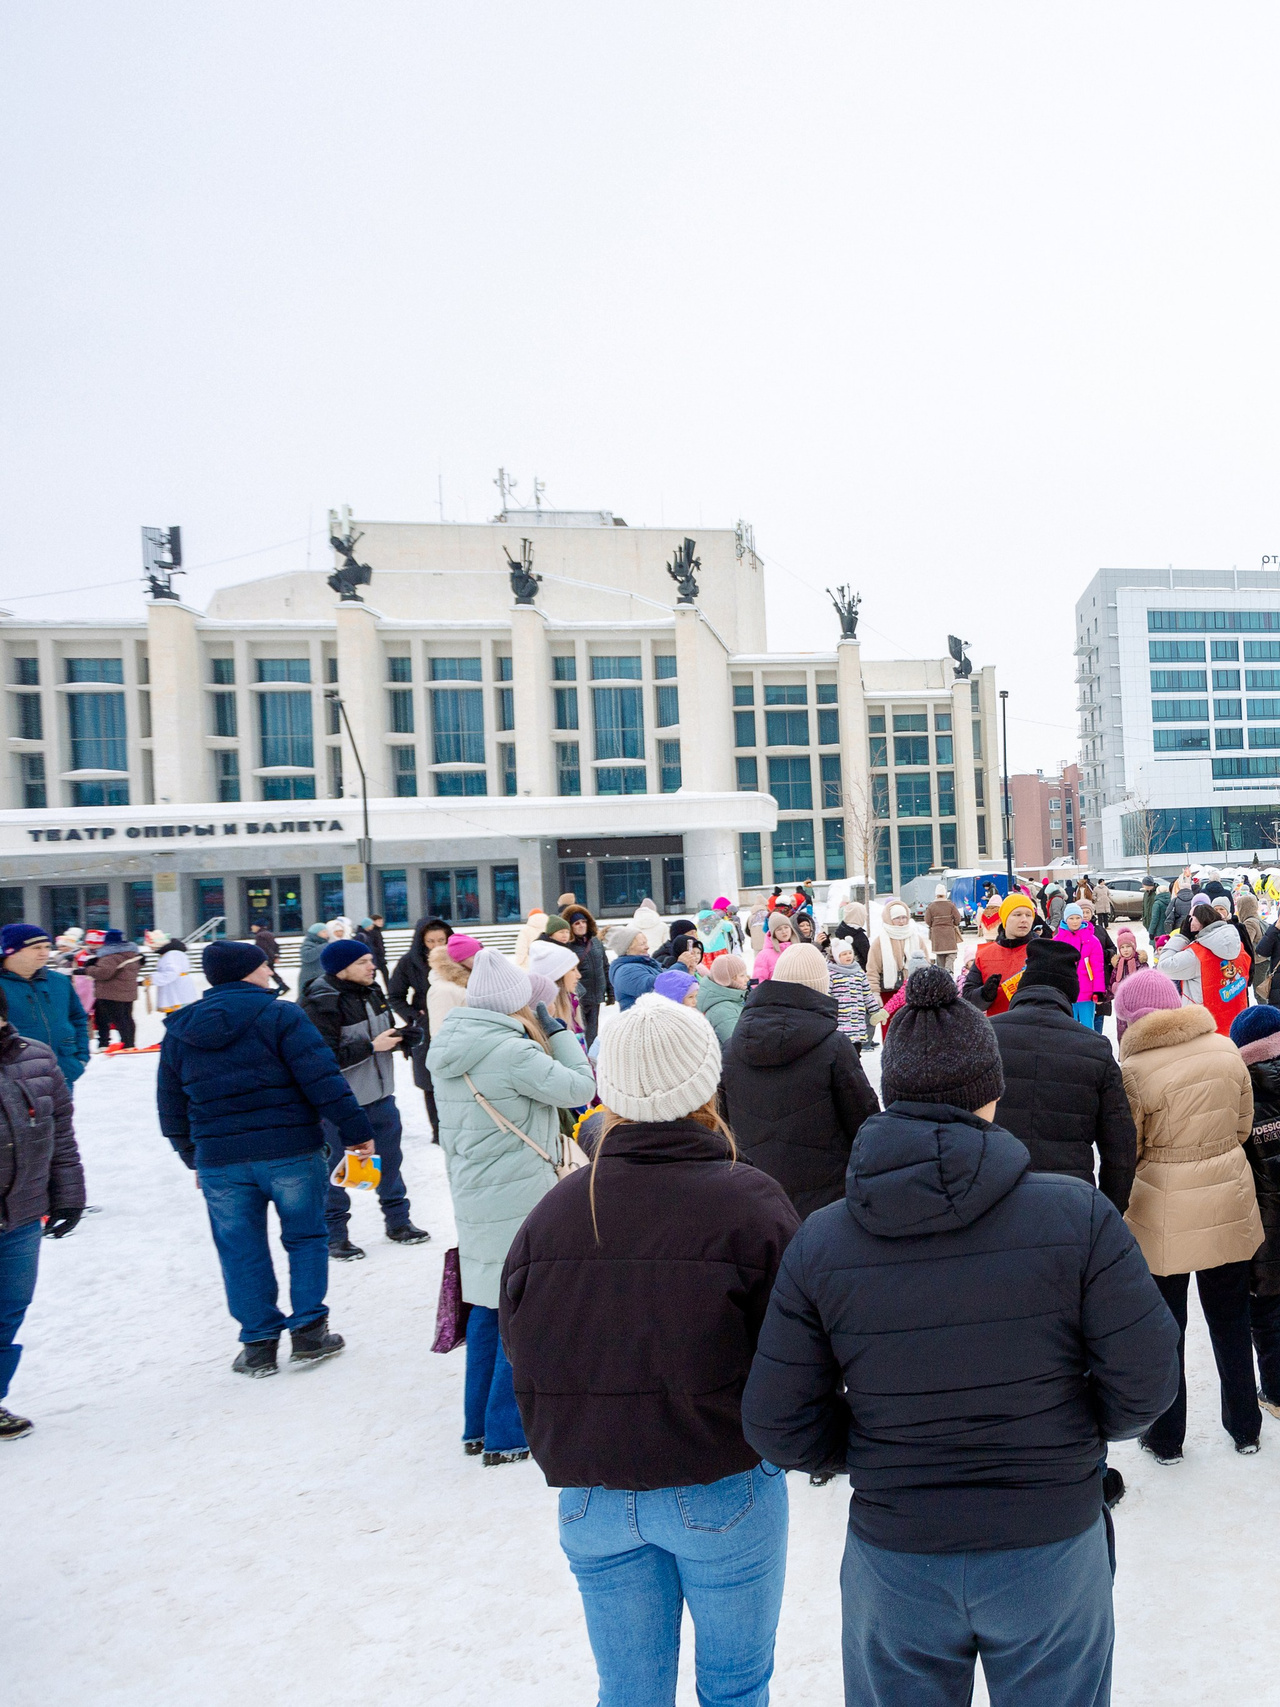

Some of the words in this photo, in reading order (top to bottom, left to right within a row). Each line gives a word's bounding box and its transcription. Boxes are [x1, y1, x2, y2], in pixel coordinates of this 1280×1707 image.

[28, 827, 115, 842] ТЕАТР
[126, 824, 215, 839] ОПЕРЫ
[223, 823, 237, 835] И
[246, 820, 343, 834] БАЛЕТА
[1253, 1135, 1263, 1145] A
